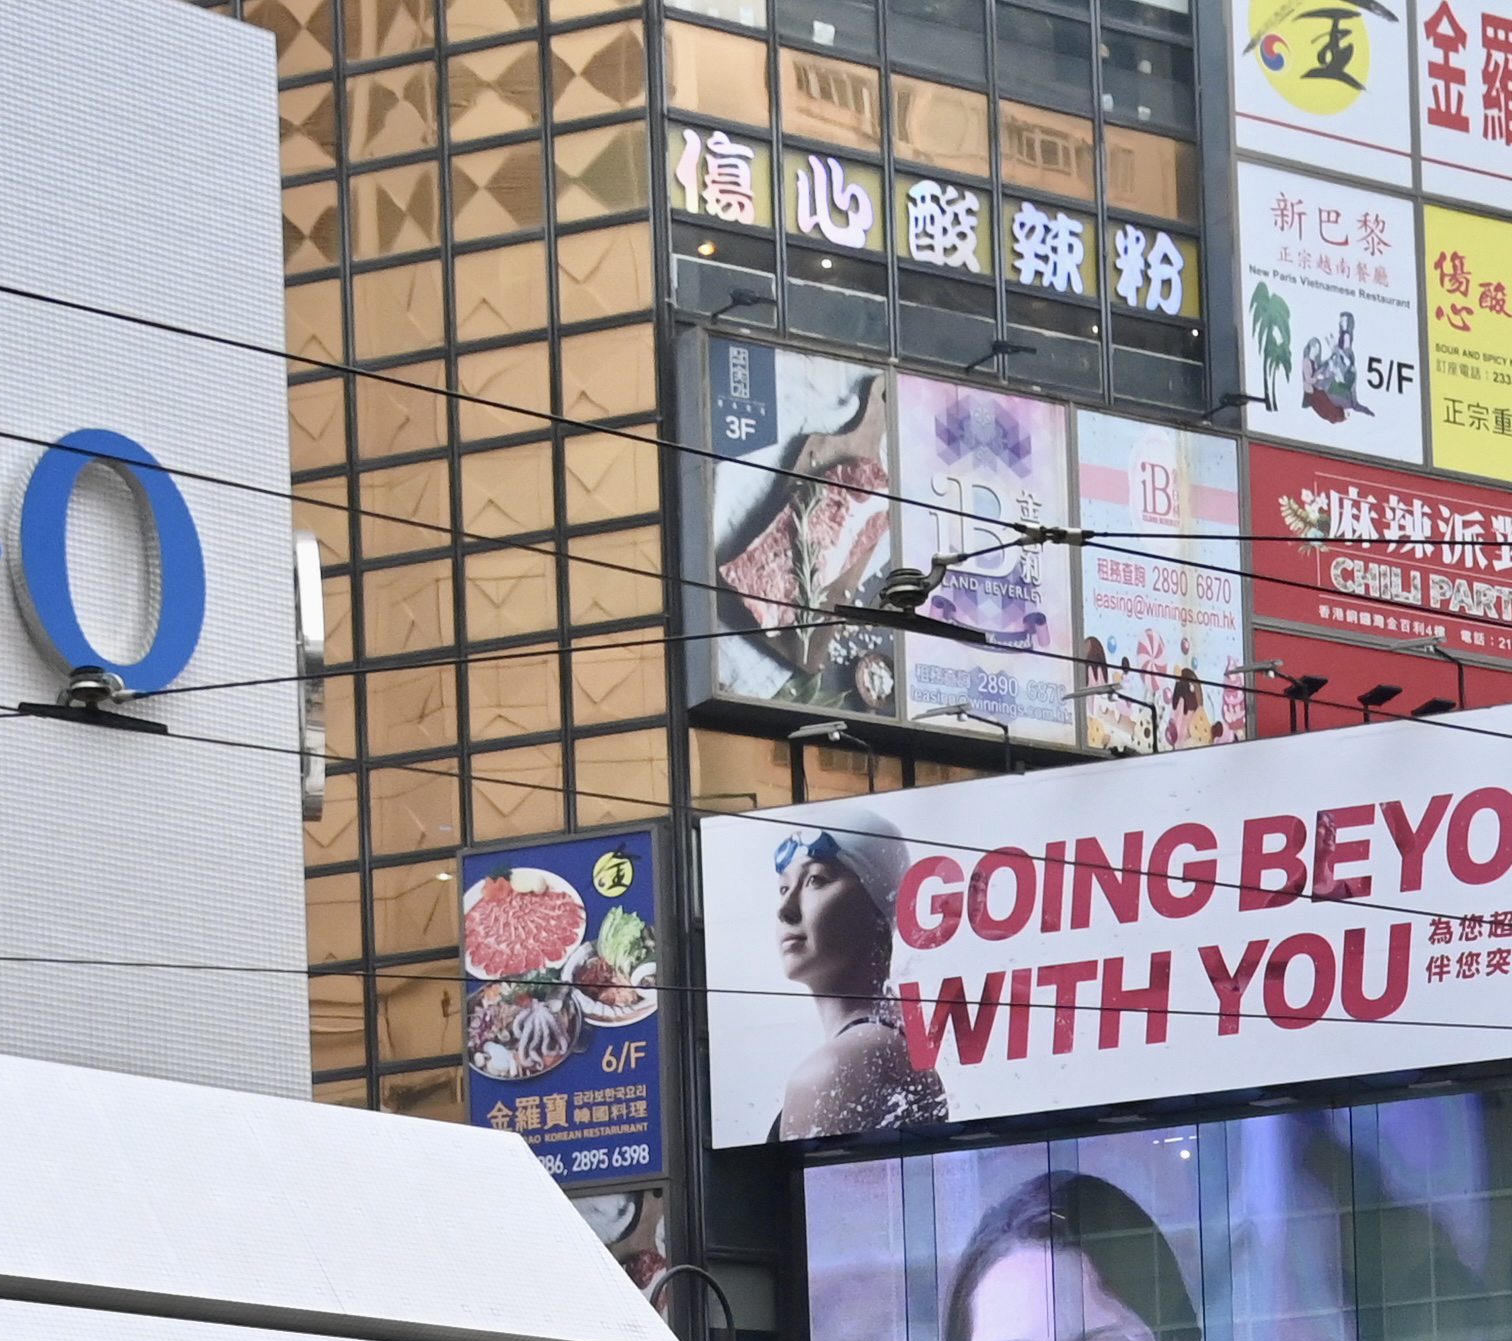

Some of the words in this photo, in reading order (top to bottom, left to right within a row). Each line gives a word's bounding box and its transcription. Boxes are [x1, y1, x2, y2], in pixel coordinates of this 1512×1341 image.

[675, 128, 1184, 316] 傷心酸辣粉
[1270, 192, 1392, 257] 新巴黎
[1249, 264, 1270, 279] New
[1273, 269, 1297, 285] Paris
[1300, 274, 1356, 298] Vietnamese
[1359, 290, 1411, 309] Restaurant
[1367, 356, 1415, 394] 5/F
[1462, 348, 1480, 361] AND
[725, 415, 756, 440] 3F
[1152, 566, 1188, 597] 2890
[1196, 574, 1232, 605] 6870
[1093, 588, 1236, 631] leasing@winnings.com.hk
[978, 673, 1019, 697] 2890
[896, 820, 1218, 948] GOING
[896, 948, 1175, 1073] WITH
[1210, 920, 1412, 1034] YOU
